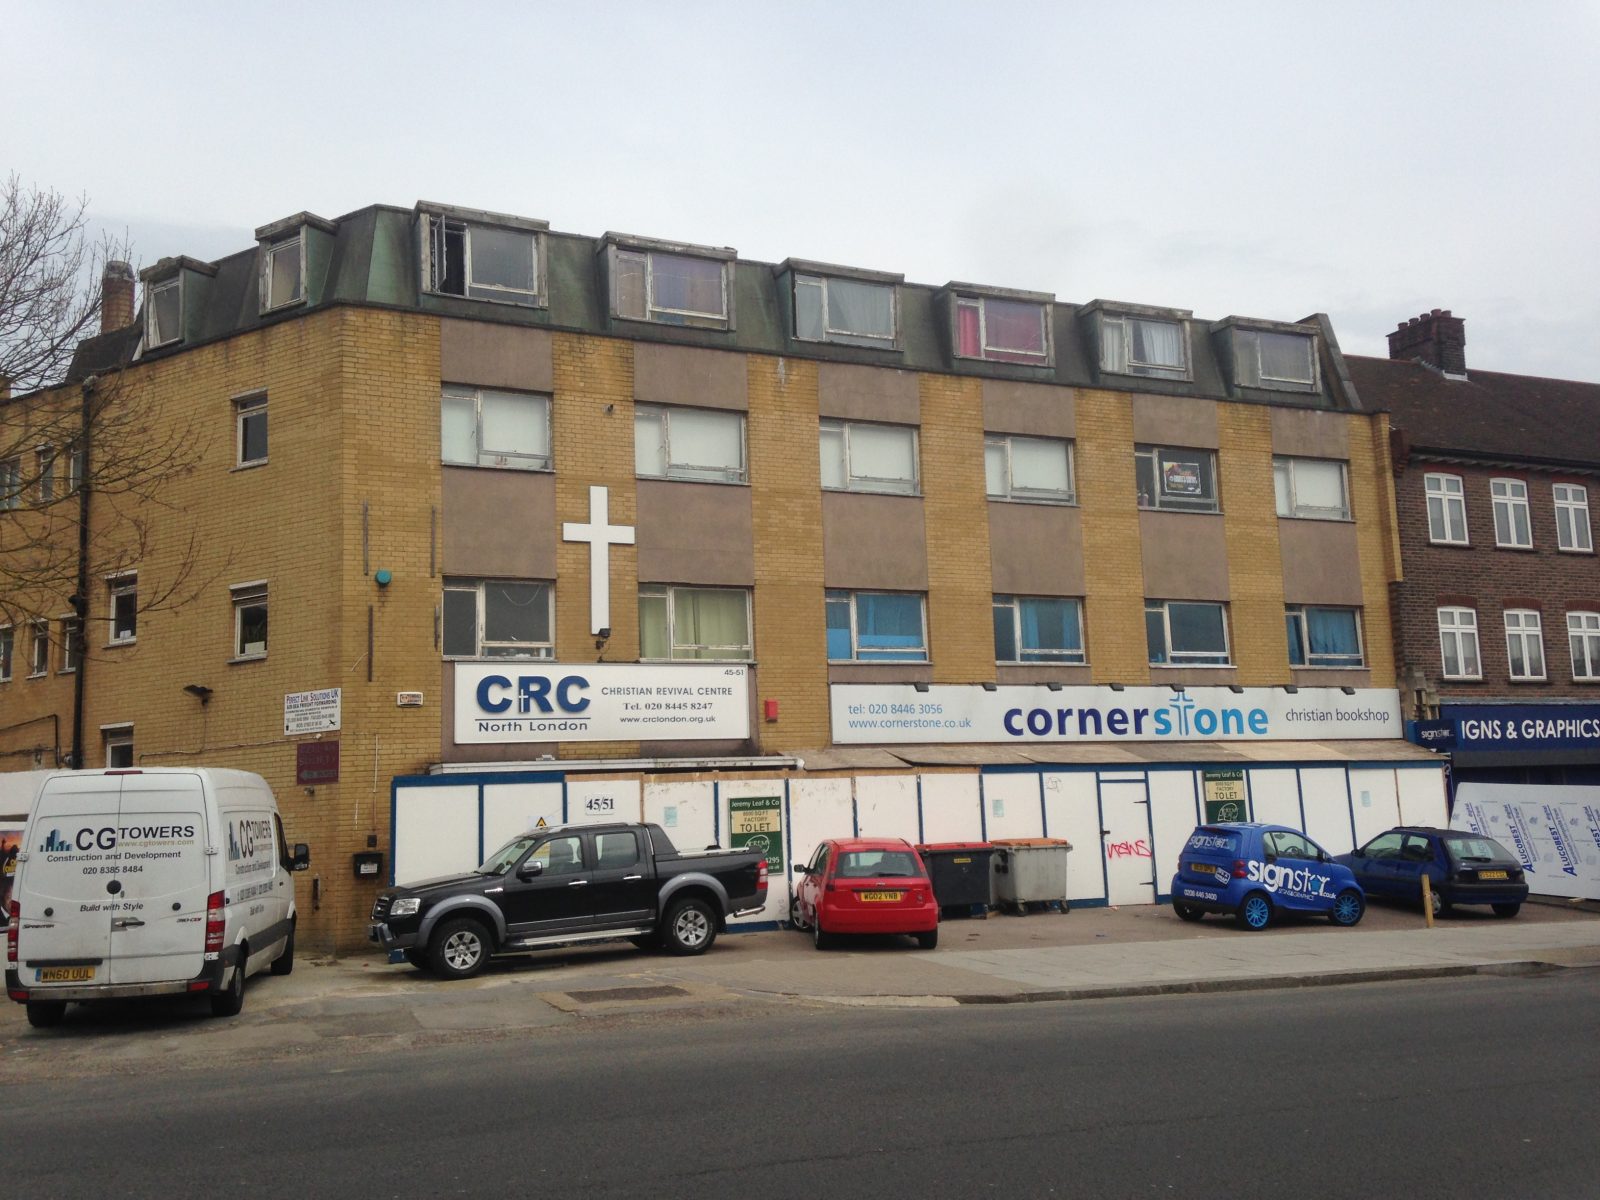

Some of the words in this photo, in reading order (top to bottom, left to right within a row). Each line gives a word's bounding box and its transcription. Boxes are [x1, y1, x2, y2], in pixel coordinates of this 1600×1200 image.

[476, 674, 591, 713] CRC
[601, 686, 652, 696] CHRISTIAN
[656, 686, 694, 696] REVIVAL
[697, 686, 733, 696] CENTRE
[623, 702, 642, 711] Tel.
[644, 702, 662, 711] 020
[665, 702, 689, 711] 8445
[690, 702, 713, 711] 8247
[848, 704, 865, 715] tel:
[868, 704, 888, 715] 020
[890, 703, 916, 715] 8446
[918, 703, 943, 714] 3056
[619, 714, 716, 724] www.crclondon.org.uk
[1003, 691, 1269, 736] cornerstone
[1285, 708, 1333, 721] christian
[1336, 708, 1390, 724] bookshop
[479, 721, 522, 732] North
[529, 720, 588, 731] London
[848, 717, 972, 729] www.cornerstone.co.uk
[1461, 720, 1502, 740] IGNS
[1506, 720, 1518, 739] &
[1521, 719, 1600, 739] GRAPHICS
[1226, 791, 1237, 800] LET
[586, 796, 615, 811] 45/51
[740, 824, 752, 832] TO
[754, 823, 771, 832] LET
[76, 827, 116, 851] CG
[118, 825, 195, 839] TOWERS
[118, 839, 194, 848] www.cgtowers.com
[240, 819, 254, 858] CG
[1509, 825, 1536, 873] ALUCOBEST
[1548, 826, 1578, 877] ALUCOBEST
[47, 854, 103, 863] Construction
[105, 853, 122, 861] and
[124, 851, 181, 861] Development
[82, 867, 98, 875] 020
[99, 866, 120, 874] 8385
[122, 865, 144, 873] 8484
[80, 904, 100, 912] Build
[102, 903, 120, 911] with
[123, 902, 144, 911] Style
[42, 968, 70, 980] WN60
[72, 968, 92, 979] UUL
